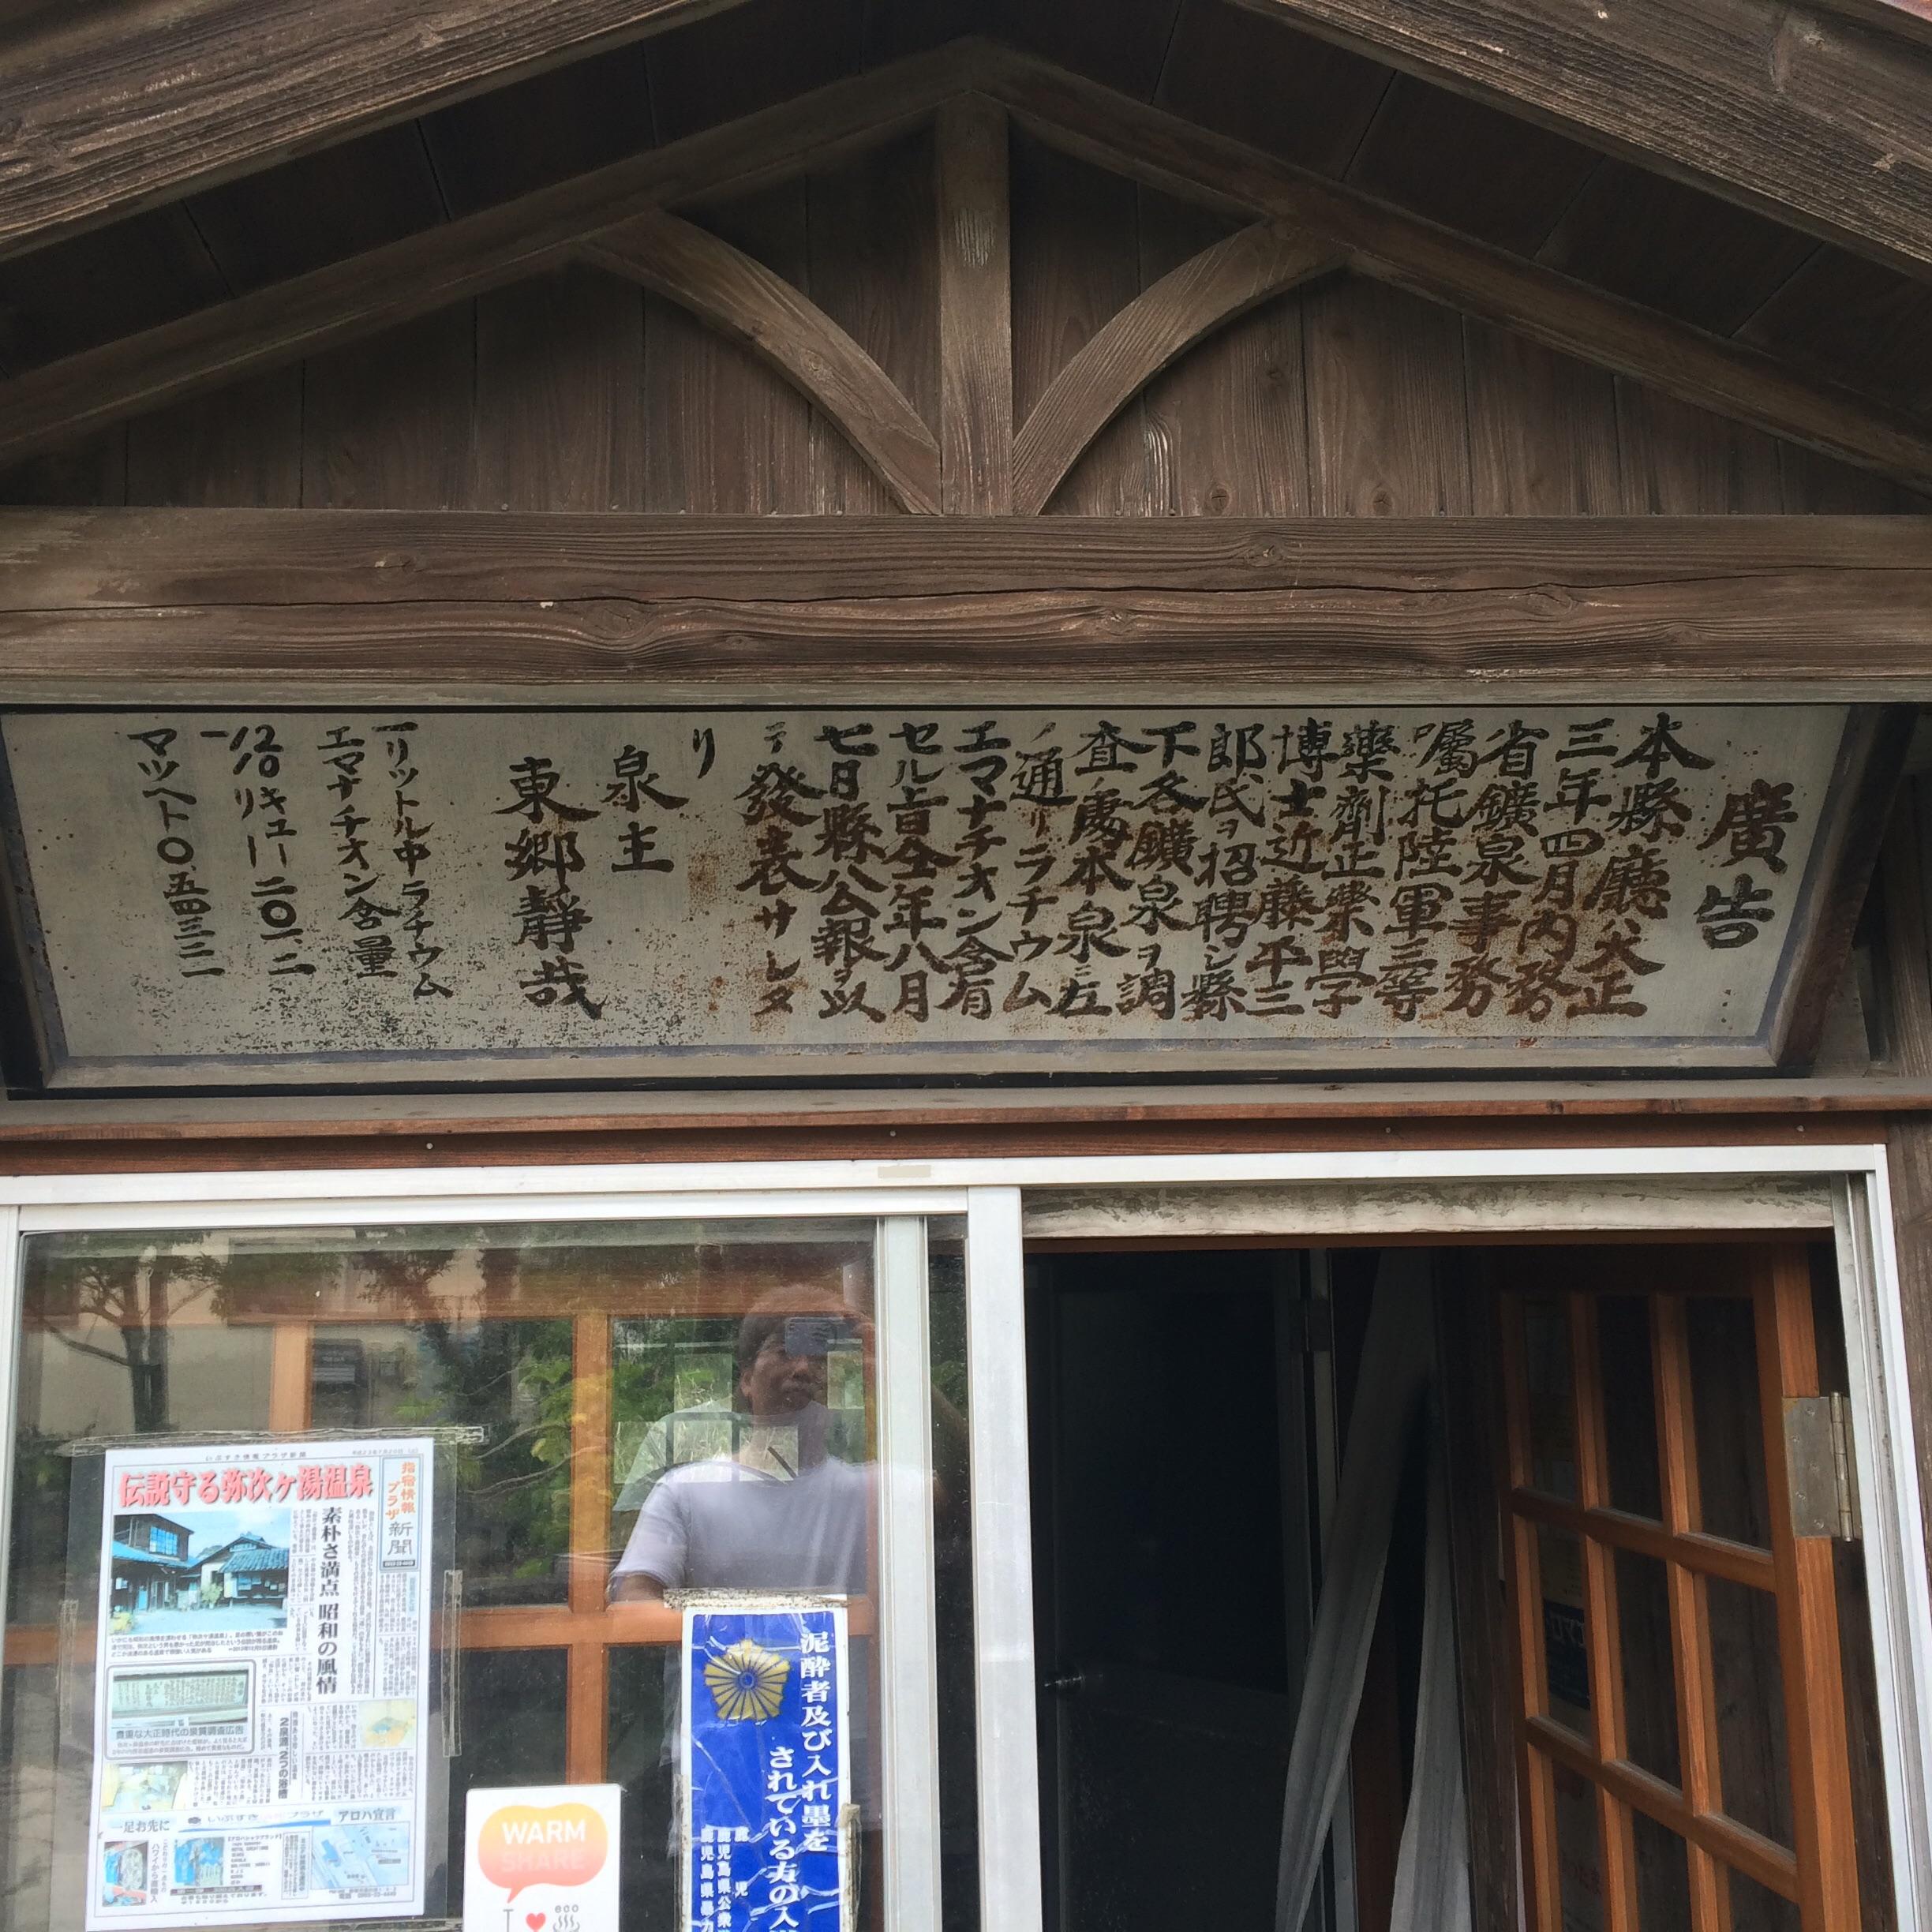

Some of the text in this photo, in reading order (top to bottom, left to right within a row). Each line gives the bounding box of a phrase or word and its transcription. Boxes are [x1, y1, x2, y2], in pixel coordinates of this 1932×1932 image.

[600, 744, 691, 874] 泉主
[1694, 778, 1799, 949] 廣告
[385, 1481, 400, 1521] プラザ
[401, 1462, 416, 1514] 指宿情報
[319, 1506, 342, 1597] 素朴さ満点
[388, 1521, 414, 1556] 新聞
[316, 1603, 339, 1695] 昭和の風情
[799, 1631, 833, 1852] 泥酔者及び入れ墨を
[500, 1818, 586, 1845] WARM
[500, 1849, 586, 1872] SHARE
[767, 1745, 800, 1932] されている方の入
[554, 1904, 579, 1913] eco
[717, 1826, 732, 1932] 鹿児島県公衆
